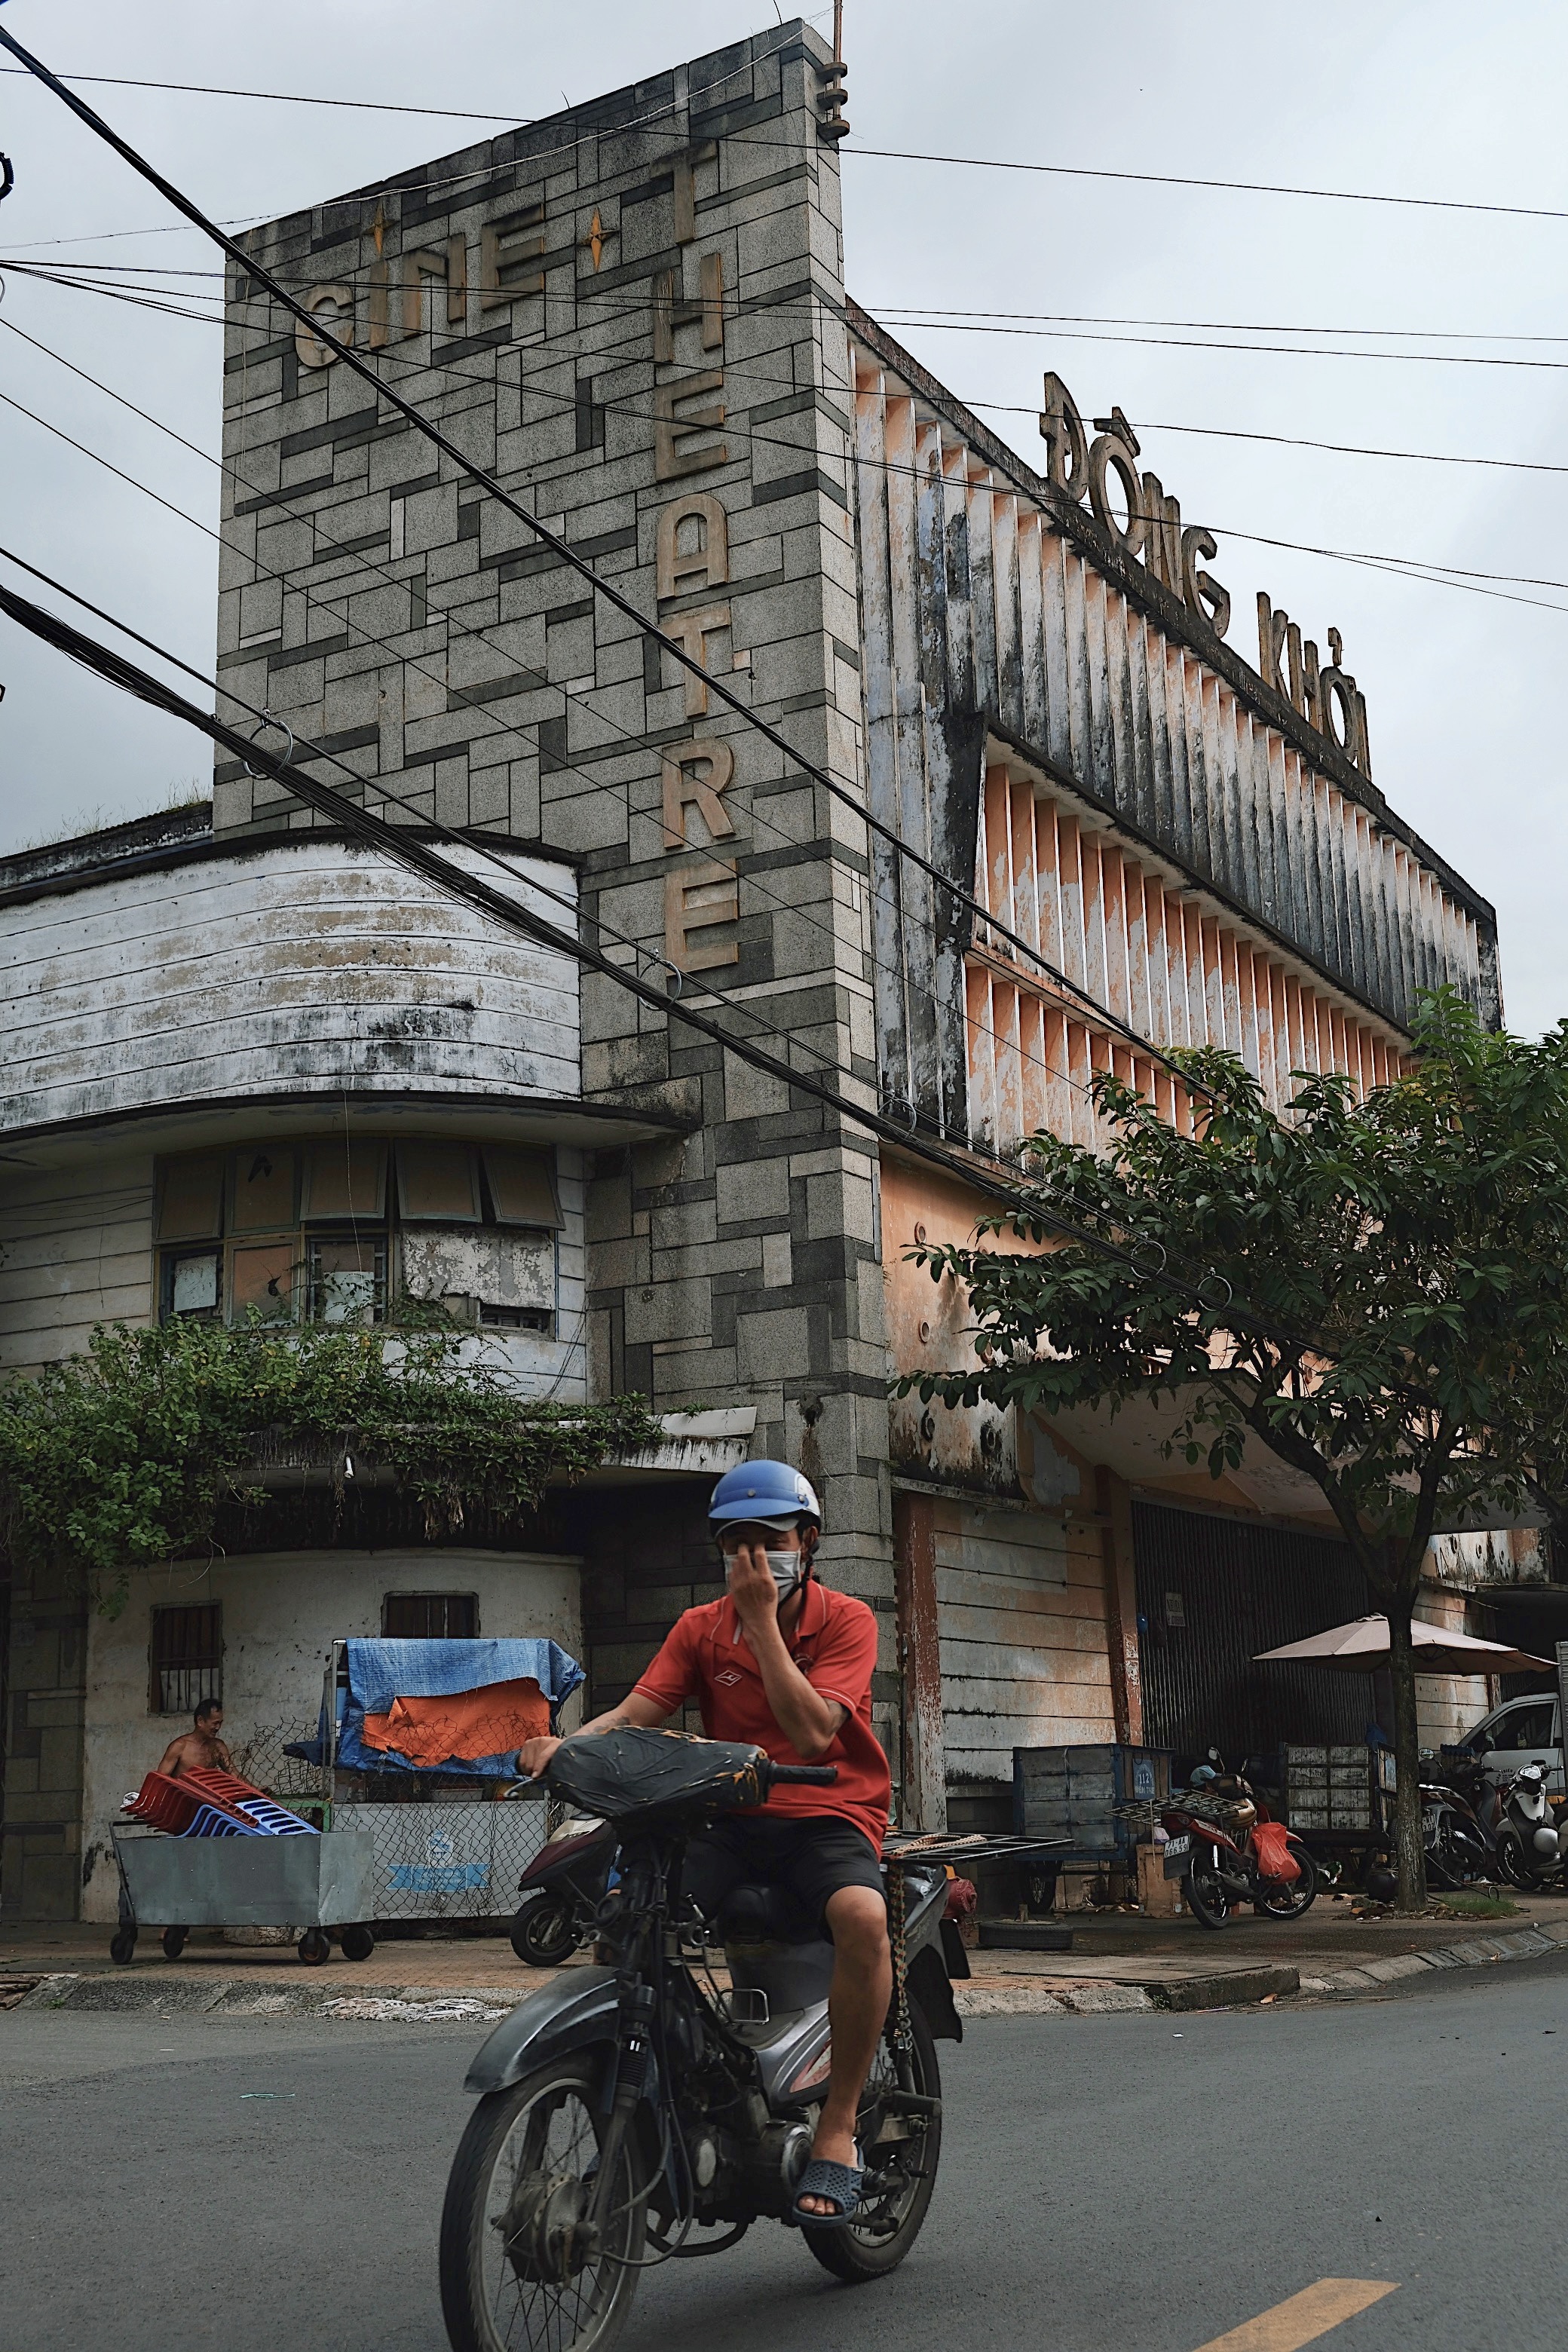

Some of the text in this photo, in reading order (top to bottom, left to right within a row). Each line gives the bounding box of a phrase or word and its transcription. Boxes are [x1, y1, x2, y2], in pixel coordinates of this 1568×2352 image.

[649, 139, 740, 975] THEATRE
[1168, 1836, 1185, 1848] 71-AA
[1165, 1843, 1187, 1857] 066.59
